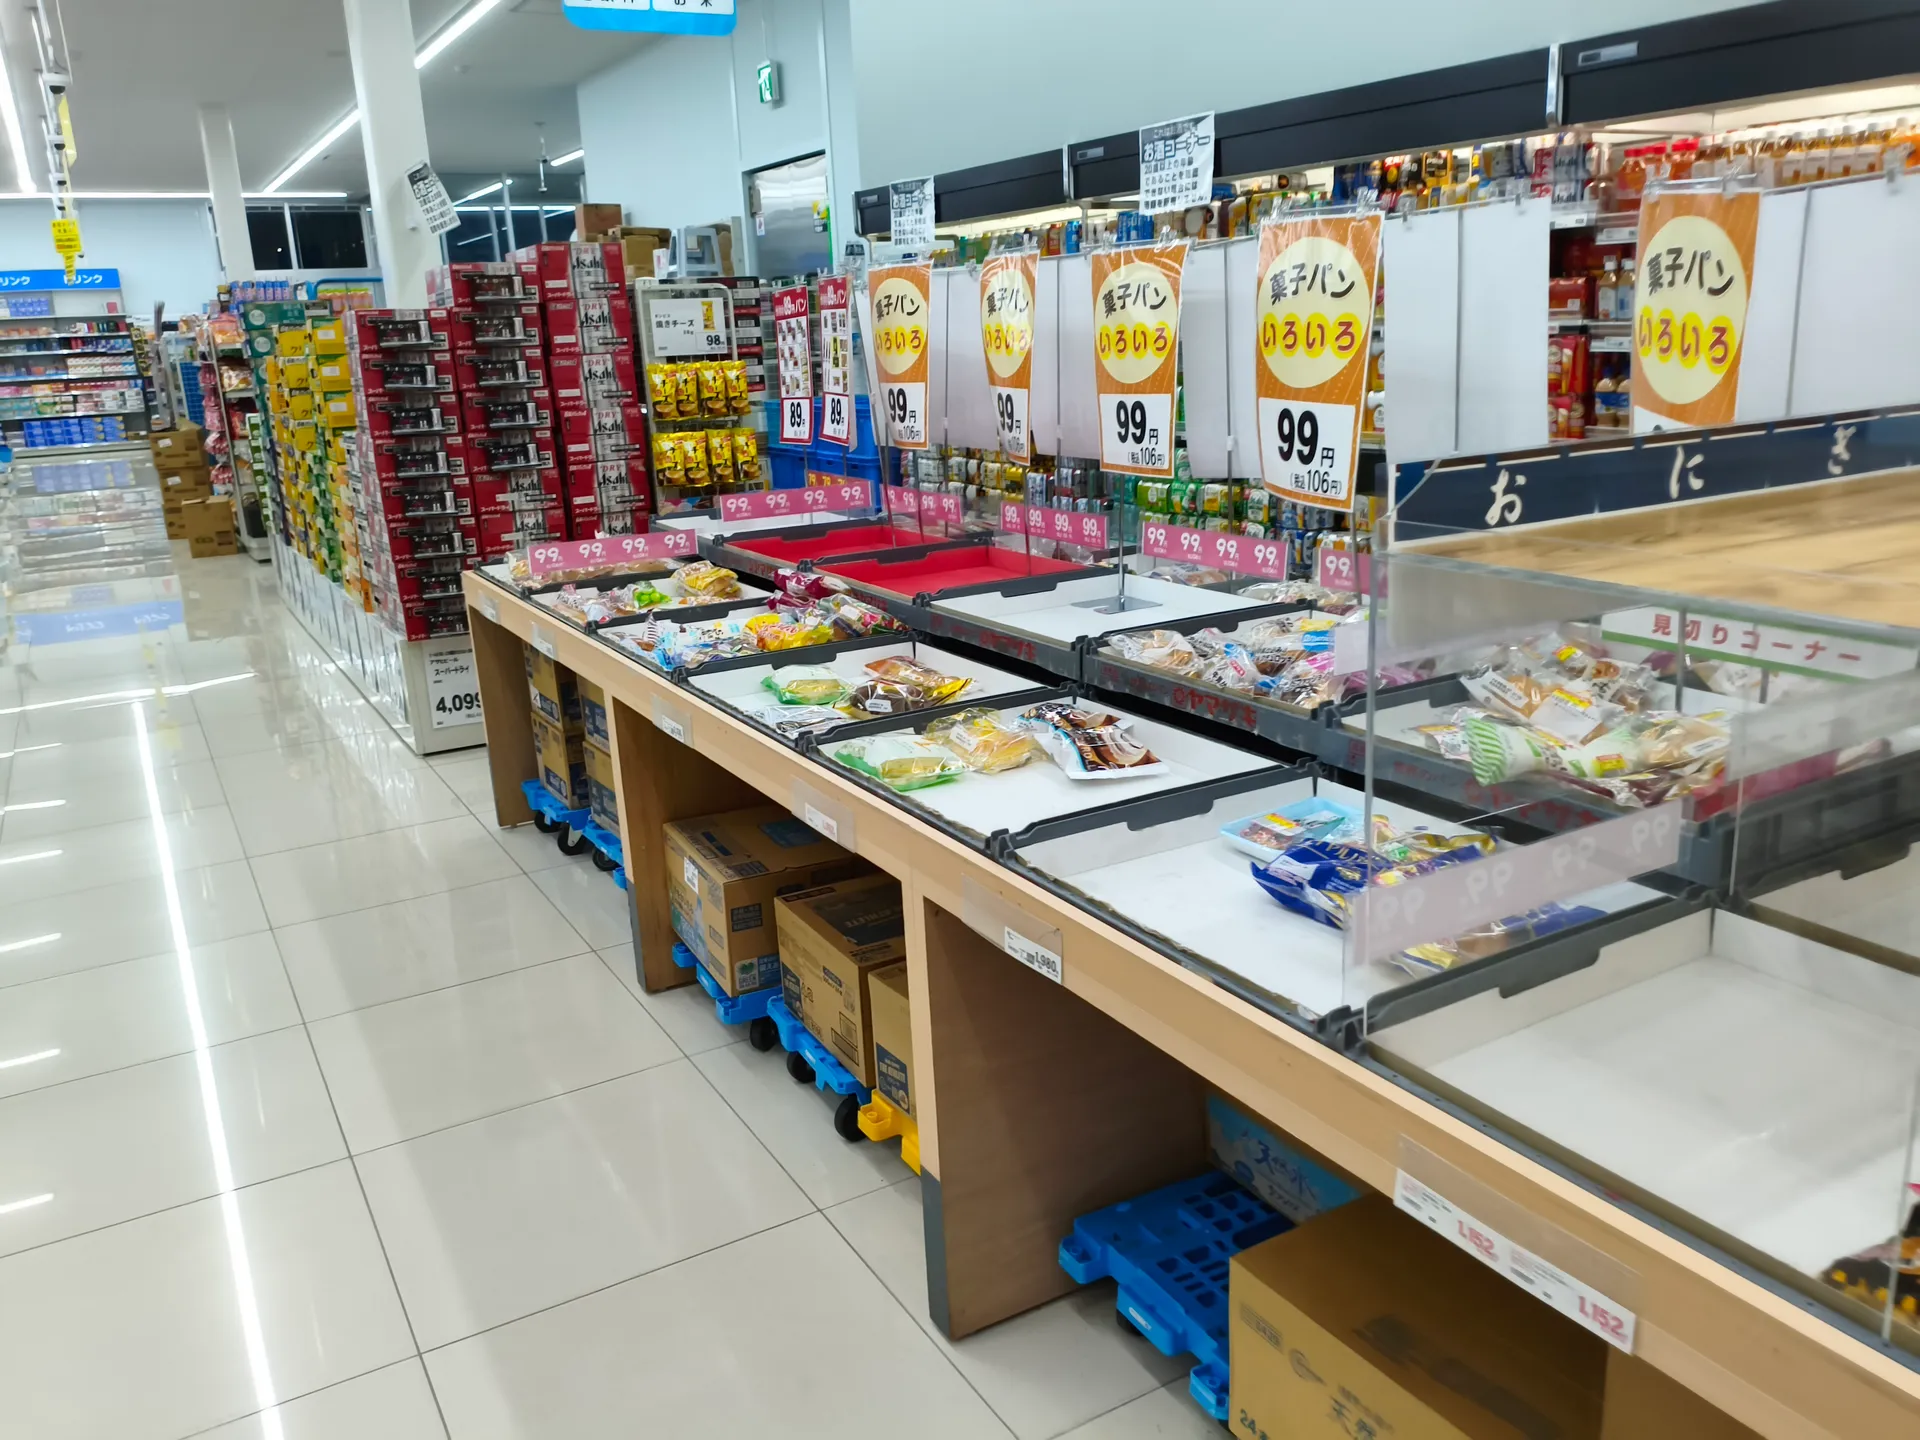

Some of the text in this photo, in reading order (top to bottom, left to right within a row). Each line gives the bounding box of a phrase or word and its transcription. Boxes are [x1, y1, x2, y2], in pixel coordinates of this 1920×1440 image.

[1143, 132, 1211, 163] お酒コーナー
[1269, 260, 1356, 305] 菓子パン
[1647, 246, 1735, 298] 菓子パン
[875, 291, 920, 323] 菓子パン
[986, 286, 1030, 318] 菓子パン
[1102, 282, 1168, 319] 菓子パン
[655, 319, 695, 329] 焼きチーズ
[874, 321, 922, 354] いろいろ
[983, 324, 1031, 357] いろいろ
[1099, 324, 1169, 356] いろいろ
[1262, 319, 1357, 357] いろいろ
[1637, 308, 1732, 367] いろいろ
[1652, 613, 1862, 663] 見切りコーナー
